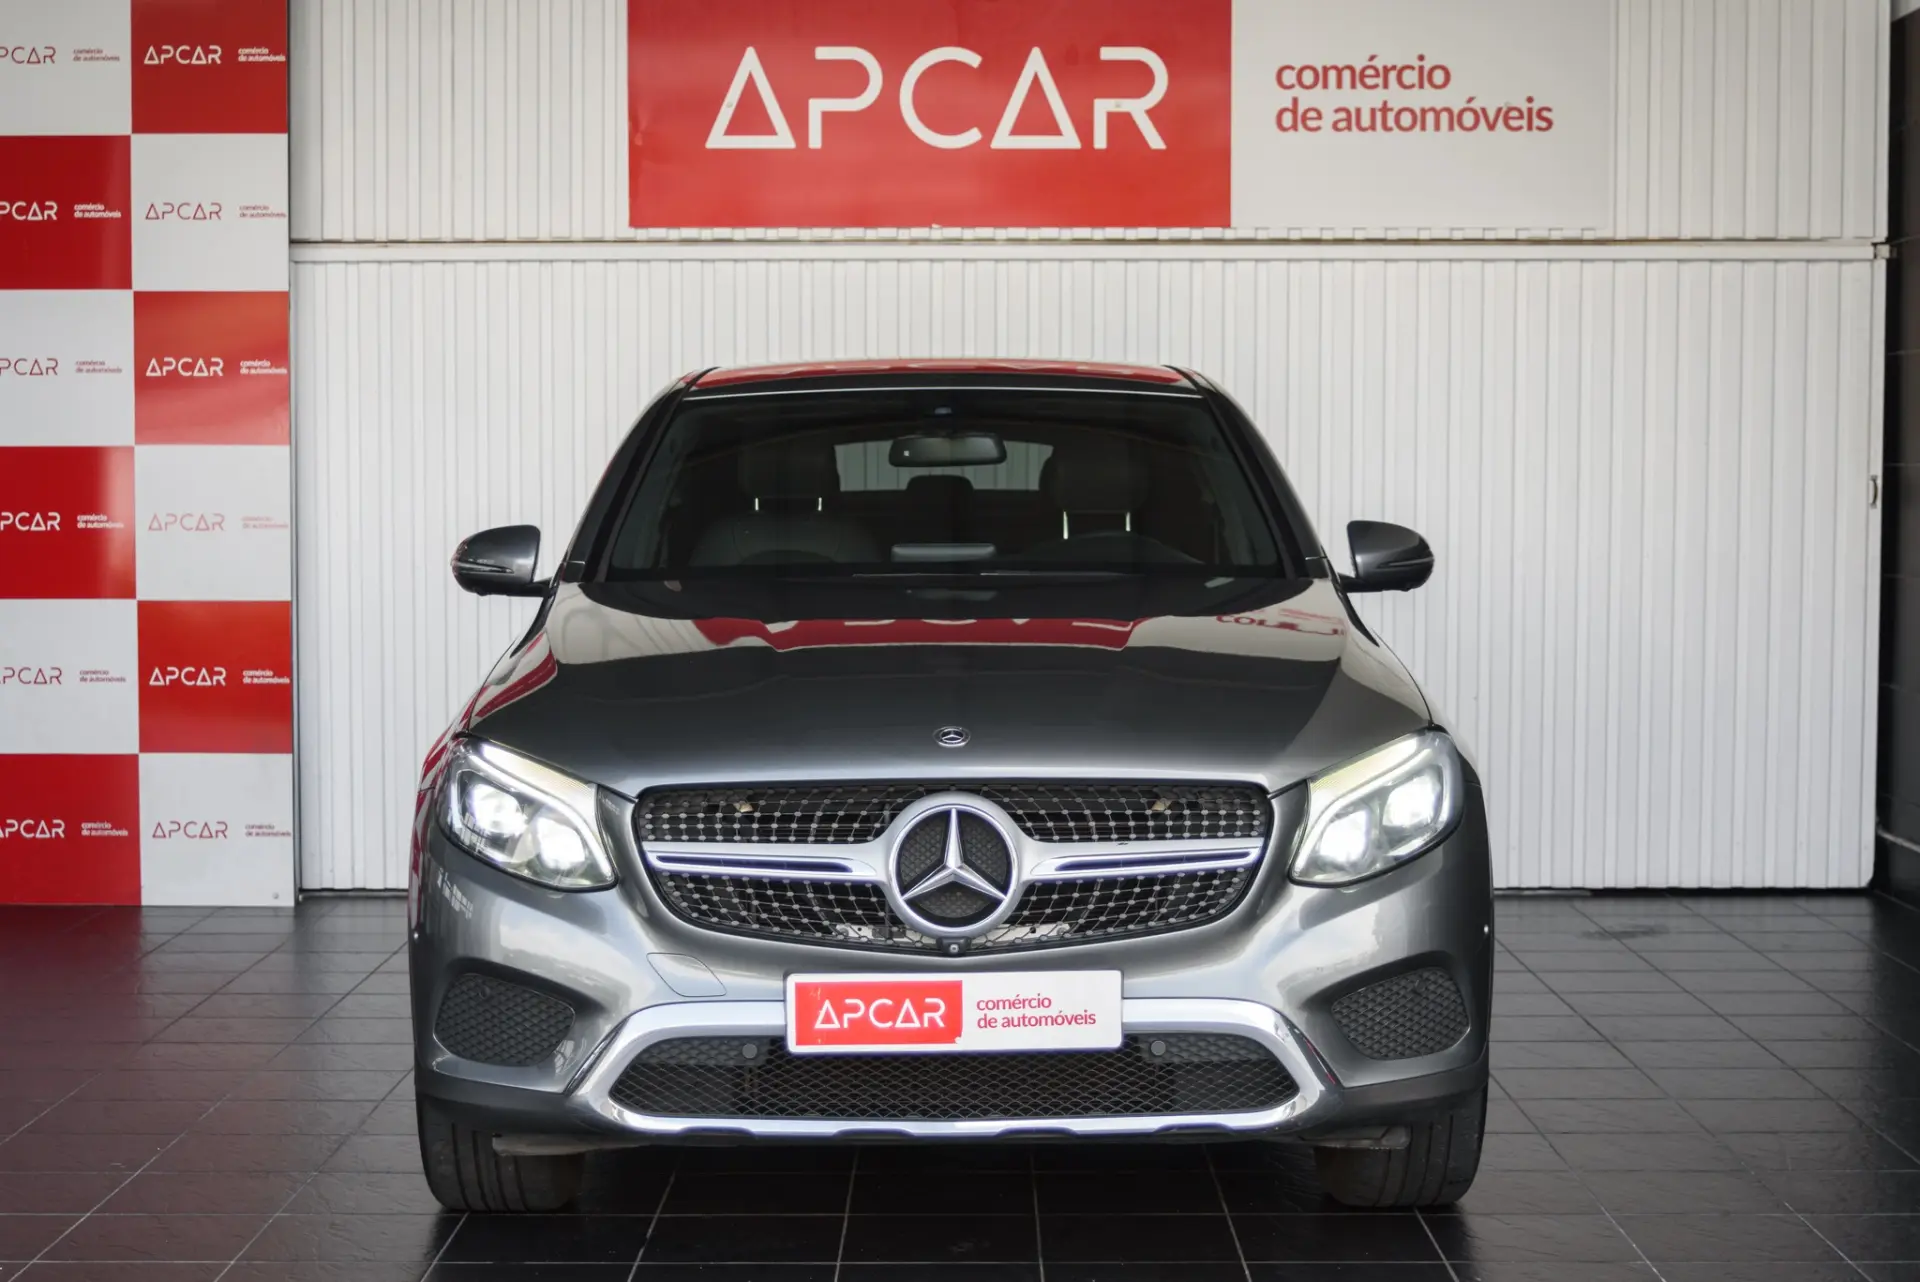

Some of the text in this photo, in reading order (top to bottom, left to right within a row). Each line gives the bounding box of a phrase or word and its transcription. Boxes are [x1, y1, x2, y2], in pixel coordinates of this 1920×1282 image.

[144, 45, 222, 64] APCAR
[1275, 55, 1451, 90] comércio
[705, 46, 1167, 149] APCAR
[1275, 96, 1554, 132] de automóveis
[145, 202, 222, 220] APCAR
[146, 357, 224, 376] APCAR
[148, 513, 225, 532] APCAR
[0, 667, 62, 685] PCAR
[149, 666, 227, 686] APCAR
[0, 819, 65, 838] PCAR
[152, 821, 228, 839] APCAR
[976, 993, 1052, 1011] comércio
[814, 998, 946, 1030] APCAR
[977, 1009, 1096, 1029] de automóveis
